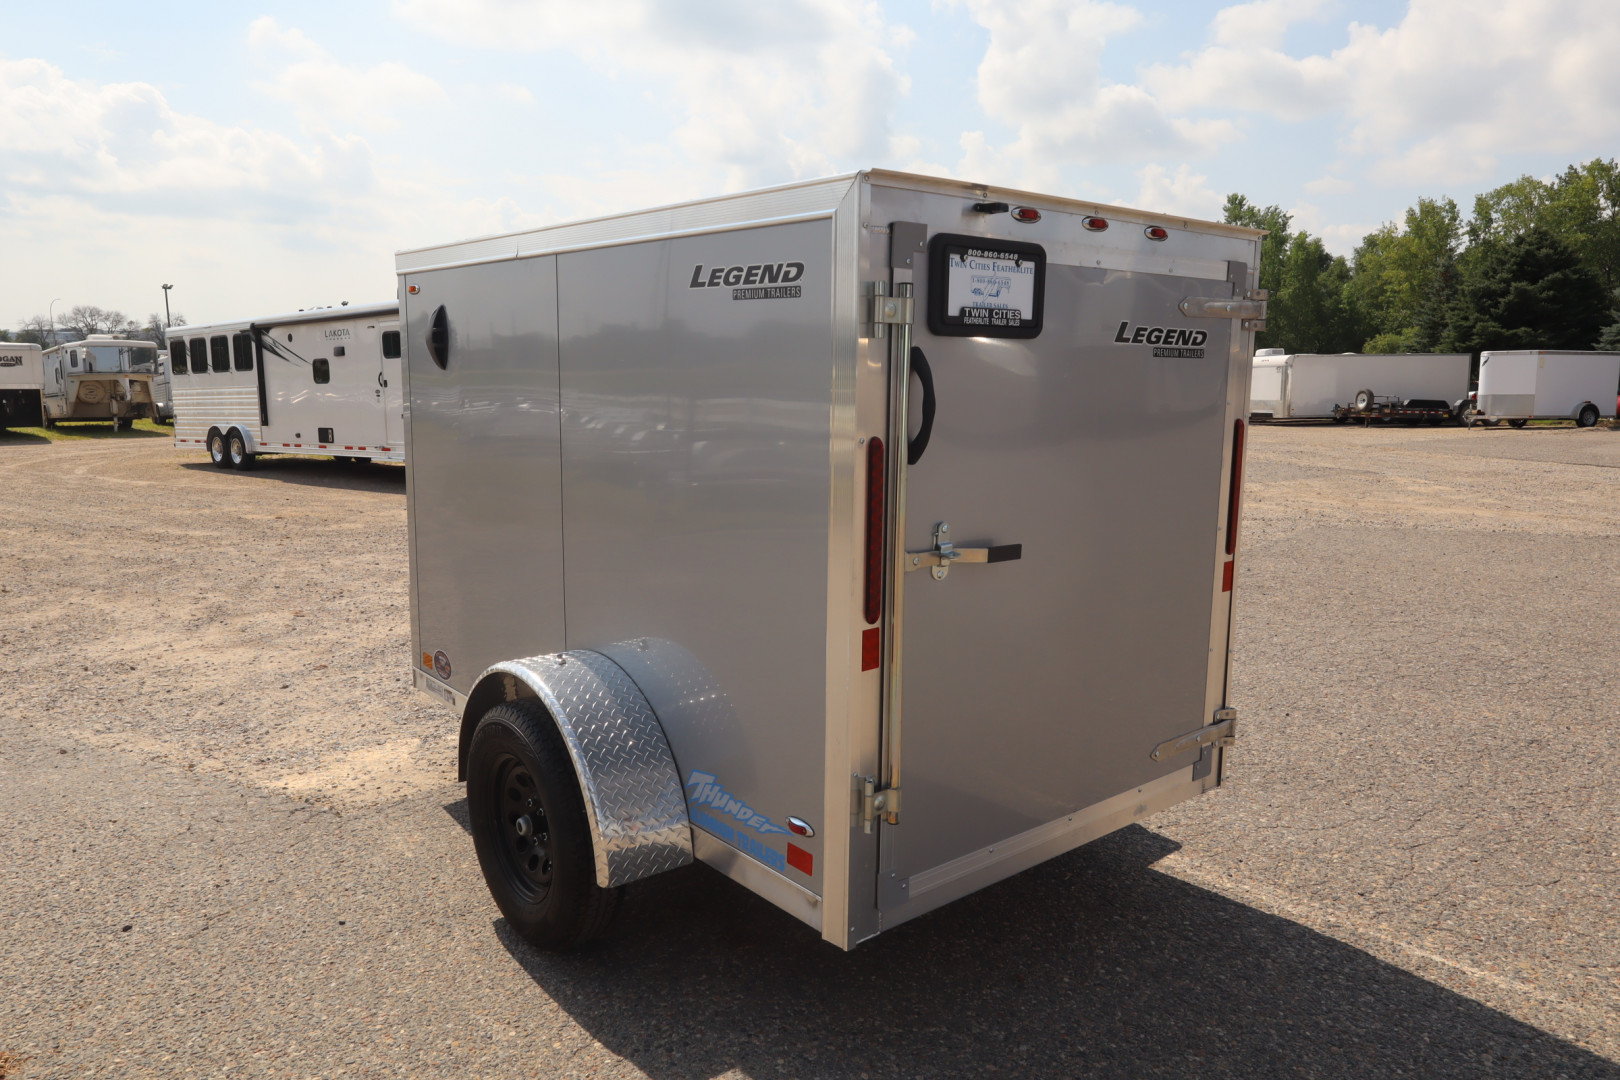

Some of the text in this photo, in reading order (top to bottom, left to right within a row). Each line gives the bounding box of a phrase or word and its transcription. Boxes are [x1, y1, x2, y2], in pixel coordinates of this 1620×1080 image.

[968, 249, 1018, 260] 800-860-6548
[689, 261, 805, 288] LEGEND
[733, 287, 801, 300] PREMIUM TRAILERS
[964, 308, 1021, 319] TWIN CITIES
[324, 328, 350, 337] LAKOTA
[1114, 321, 1208, 346] LEGEND
[1153, 348, 1204, 358] PREMIUM TRAILERS
[686, 769, 794, 836] THUNDER
